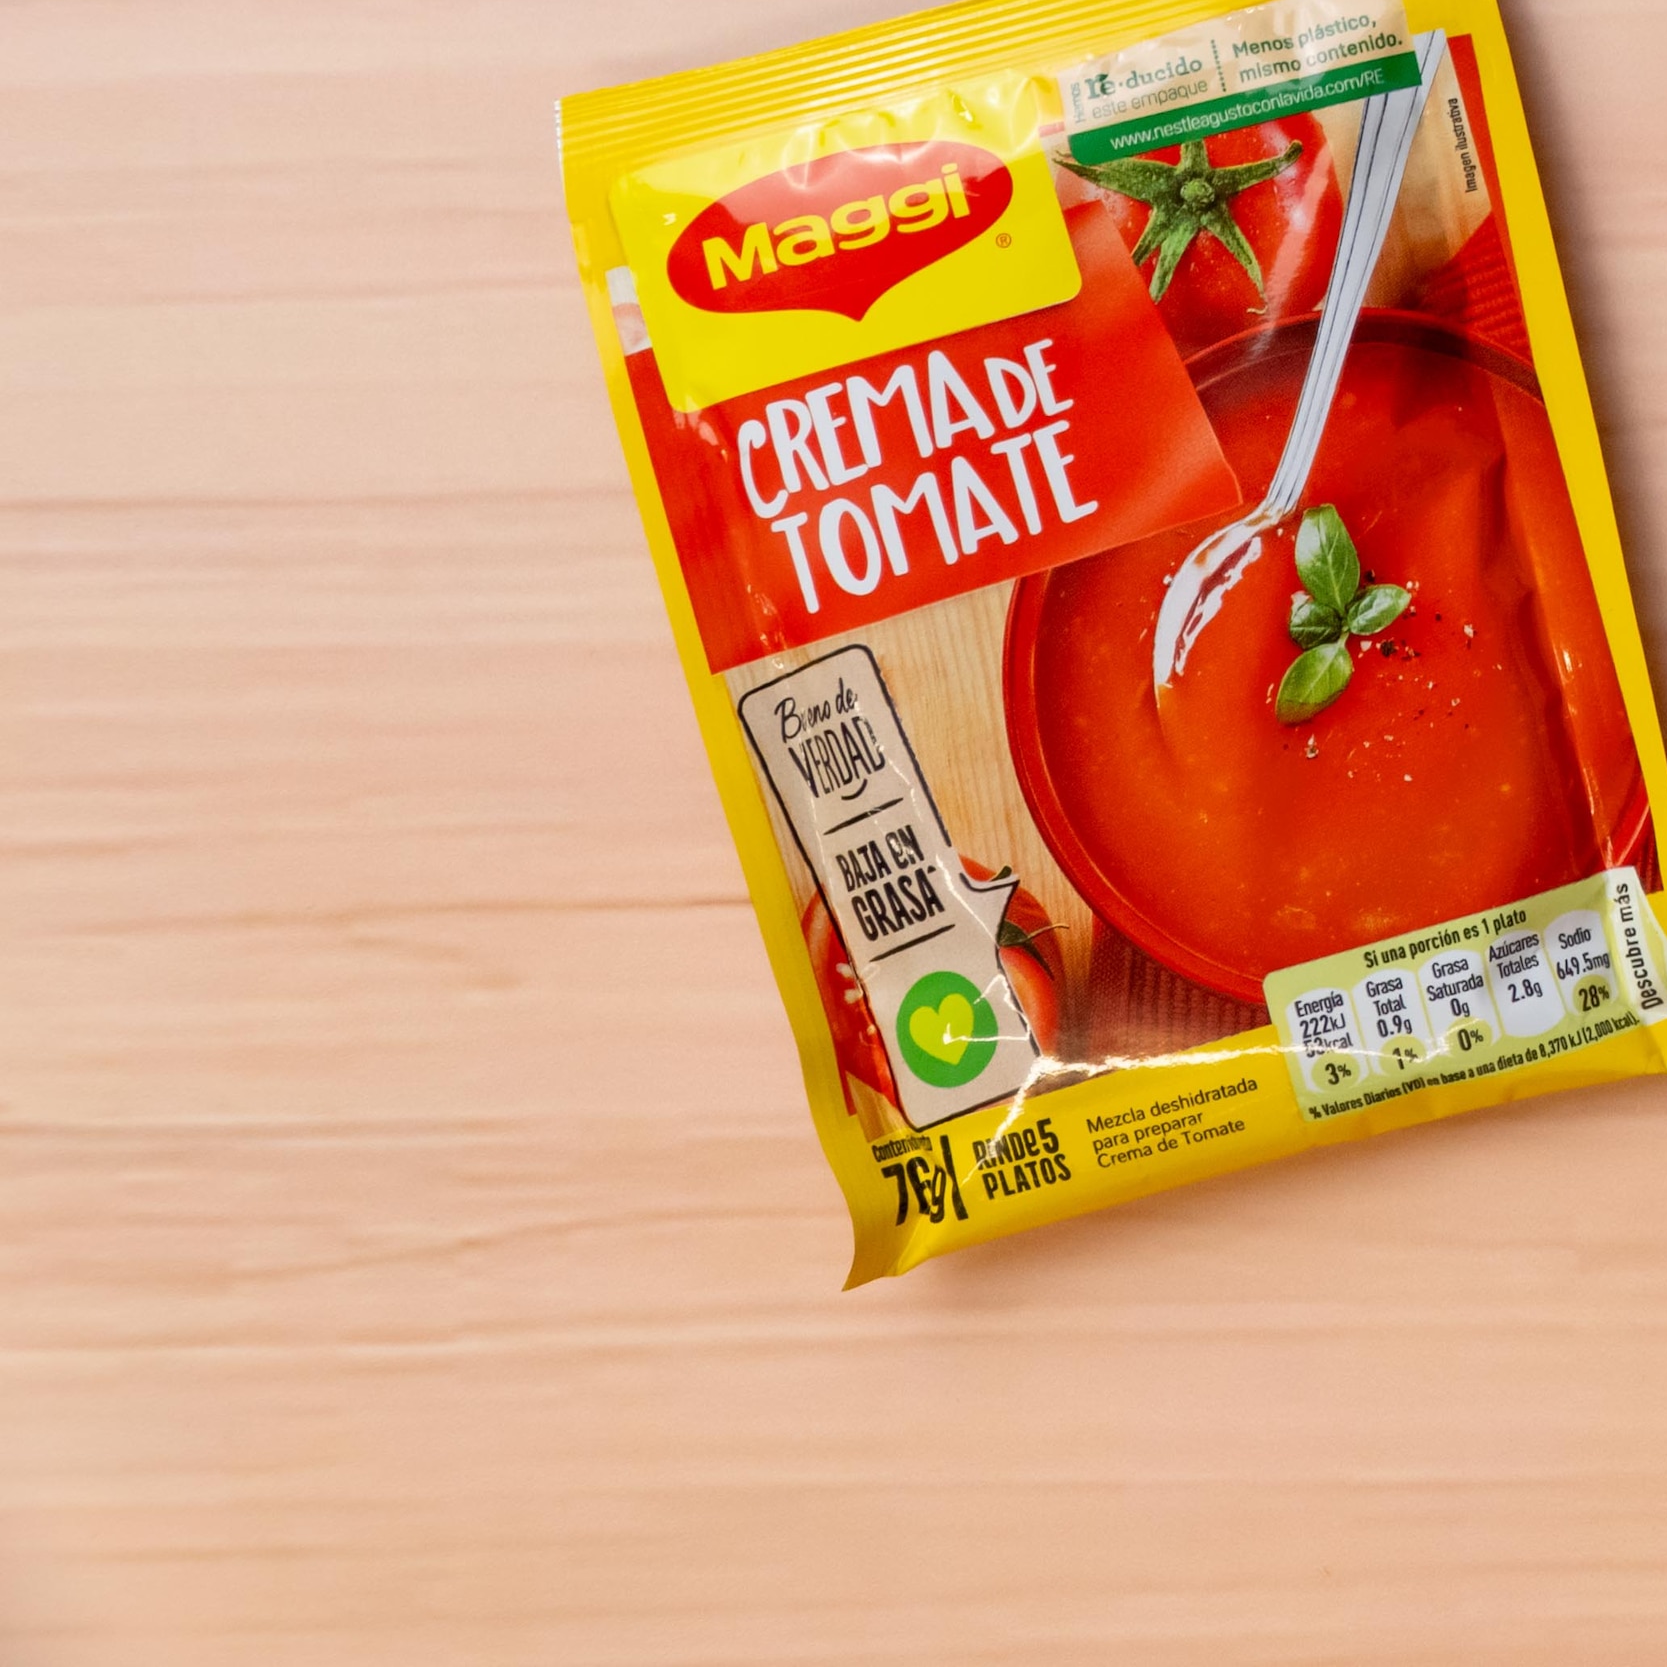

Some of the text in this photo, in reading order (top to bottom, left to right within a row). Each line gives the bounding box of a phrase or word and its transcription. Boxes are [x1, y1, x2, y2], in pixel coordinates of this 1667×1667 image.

[1232, 13, 1377, 59] Menos plástico,
[1238, 32, 1403, 83] mismo contenido.
[1092, 79, 1209, 119] este empaque
[1109, 67, 1386, 151] www.nestleagustoconlavida.com/RE
[1447, 97, 1478, 194] Imagen ilustrativa
[702, 162, 971, 291] Maggi
[737, 339, 1074, 519] CREMA DE
[771, 420, 1098, 615] TOMATE
[835, 677, 858, 715] de
[788, 716, 886, 798] VERDAD
[835, 840, 892, 892] BAJA
[851, 865, 946, 942] GRASA
[1364, 910, 1527, 968] Si una porción es 1 plato
[1488, 933, 1540, 962] Azúcares
[1558, 927, 1592, 949] Sodio
[1614, 883, 1664, 1010] Descubre más
[1431, 958, 1470, 979] Grasa
[1497, 954, 1540, 979] Totales
[1556, 952, 1611, 980] 649.5mg
[1294, 991, 1344, 1018] Energía
[1365, 976, 1404, 998] Grasa
[1373, 995, 1407, 1017] Total
[1426, 974, 1485, 1001] Saturada
[1507, 979, 1544, 1003] 2.8g
[1579, 984, 1610, 1012] 28%
[1299, 1014, 1346, 1040] 222kJ
[1377, 1015, 1413, 1038] 0.9g
[1450, 998, 1471, 1018] 0g
[1457, 1029, 1484, 1052] 0%
[1322, 1096, 1363, 1116] Valores
[1363, 1086, 1402, 1105] Diarios
[1401, 1077, 1426, 1095] (VD)
[1440, 1071, 1467, 1084] base
[1468, 1069, 1475, 1078] a
[1476, 1062, 1496, 1076] una
[1497, 1052, 1524, 1071] dieta
[1525, 1048, 1538, 1064] de
[1539, 1036, 1568, 1058] 8,370
[1568, 1032, 1582, 1047] kJ
[1583, 1019, 1614, 1044] (2,000
[1325, 1063, 1352, 1085] 3%
[1086, 1077, 1258, 1134] Mezcla deshidratada
[1036, 1117, 1060, 1154] 5
[1092, 1112, 1204, 1154] para preparar
[1097, 1118, 1246, 1169] Crema de Tomate
[881, 1156, 947, 1227] 76g
[982, 1153, 1072, 1201] PLATOS
